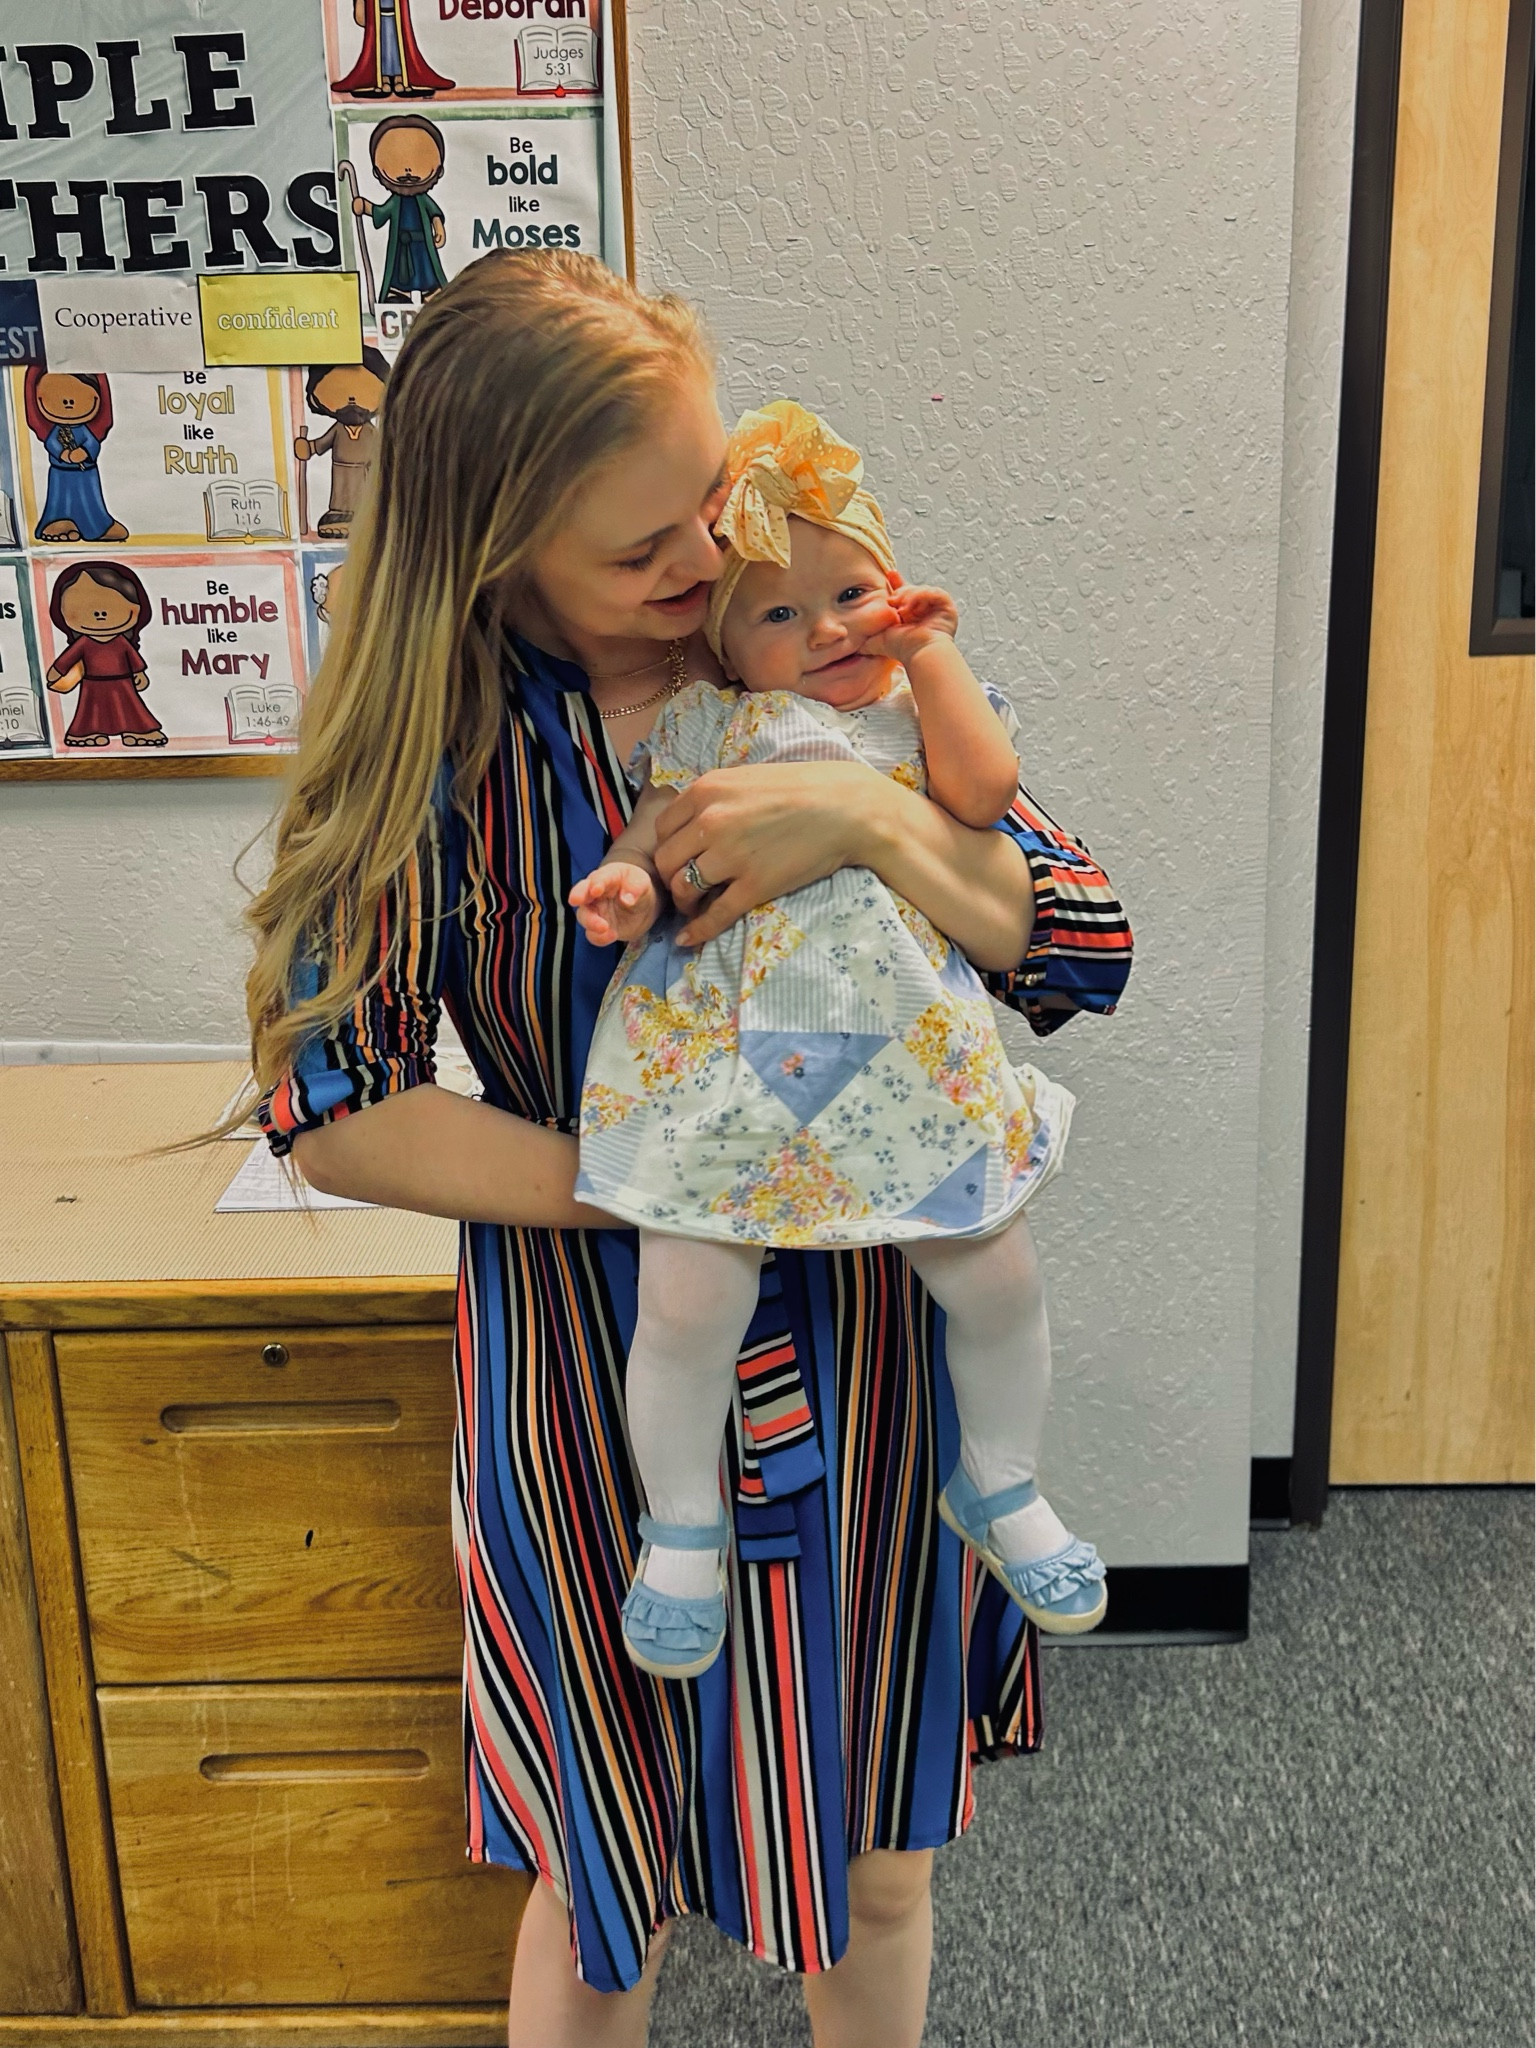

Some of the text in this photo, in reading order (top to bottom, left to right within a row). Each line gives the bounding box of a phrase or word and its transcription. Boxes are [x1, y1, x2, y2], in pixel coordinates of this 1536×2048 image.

[534, 47, 584, 62] Judges
[545, 63, 572, 76] 5:31
[510, 137, 533, 153] Be
[487, 154, 558, 186] bold
[509, 196, 540, 213] like
[0, 172, 342, 272] HERS
[473, 218, 581, 249] Moses
[54, 307, 192, 335] Cooperative
[217, 306, 340, 331] confident
[184, 371, 207, 385] Be
[158, 385, 235, 421] loyal
[183, 424, 215, 440] like
[164, 445, 239, 475] Ruth
[231, 499, 262, 510] Ruth
[235, 513, 261, 525] 1:16
[206, 580, 230, 596] Be
[160, 595, 279, 626] humble
[207, 628, 238, 644] like
[181, 648, 270, 681] Mary
[0, 704, 25, 716] niel
[251, 702, 281, 714] Luke
[246, 715, 290, 728] 1:46-49
